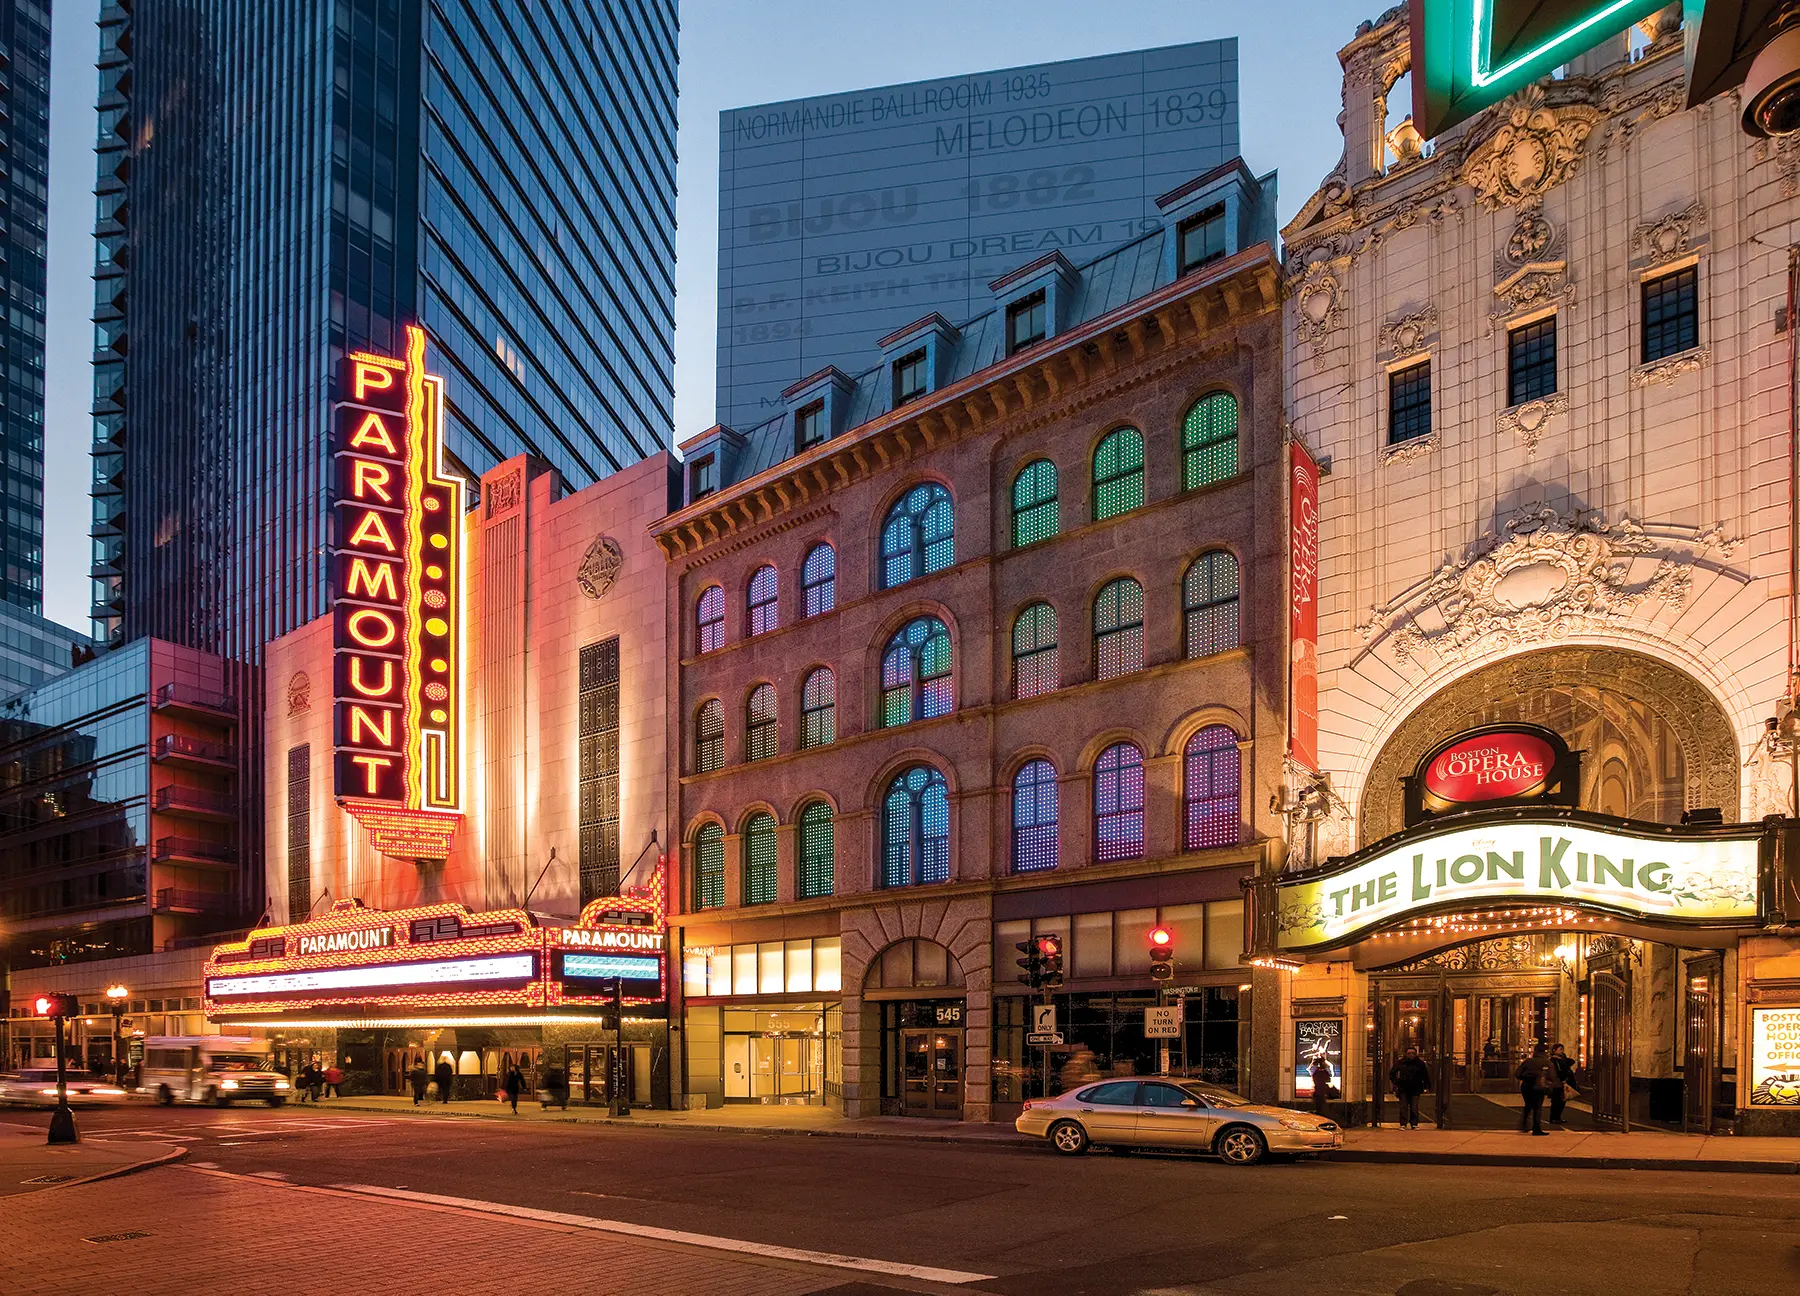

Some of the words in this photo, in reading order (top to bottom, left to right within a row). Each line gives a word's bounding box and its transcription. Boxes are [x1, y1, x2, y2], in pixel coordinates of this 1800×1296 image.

[738, 99, 865, 142] NORMANDIE
[872, 79, 992, 121] BALLROOM
[1002, 72, 1051, 102] 1935
[935, 101, 1128, 156] MELODEON
[1148, 88, 1227, 128] 1839
[750, 186, 919, 242] BIJOU
[960, 165, 1096, 213] 1882
[817, 245, 932, 274] BIJOU
[950, 224, 1102, 259] DREAM
[735, 291, 793, 314] B.F.
[806, 277, 911, 306] KEITH
[735, 319, 814, 344] 1894
[1301, 497, 1312, 602] OPERA
[1309, 508, 1318, 578] BOSTON
[348, 362, 398, 795] PARAMOUNT
[1293, 525, 1301, 621] HOUSE
[1448, 751, 1528, 775] OPERA
[1451, 747, 1499, 762] BOSTON
[1476, 764, 1543, 785] HOUSE
[1329, 871, 1398, 916] THE
[1412, 850, 1525, 902] LION
[1539, 836, 1674, 892] KING
[300, 927, 390, 955] PARAMOUNT
[562, 929, 664, 950] PARAMOUNT
[1162, 987, 1194, 995] WASHINGTON
[768, 1019, 790, 1029] 555
[936, 1007, 961, 1021] 545
[1299, 1021, 1338, 1030] BOSTON
[1148, 1026, 1159, 1034] ON
[1766, 1033, 1800, 1041] HOU
[1775, 1042, 1800, 1050] BOX
